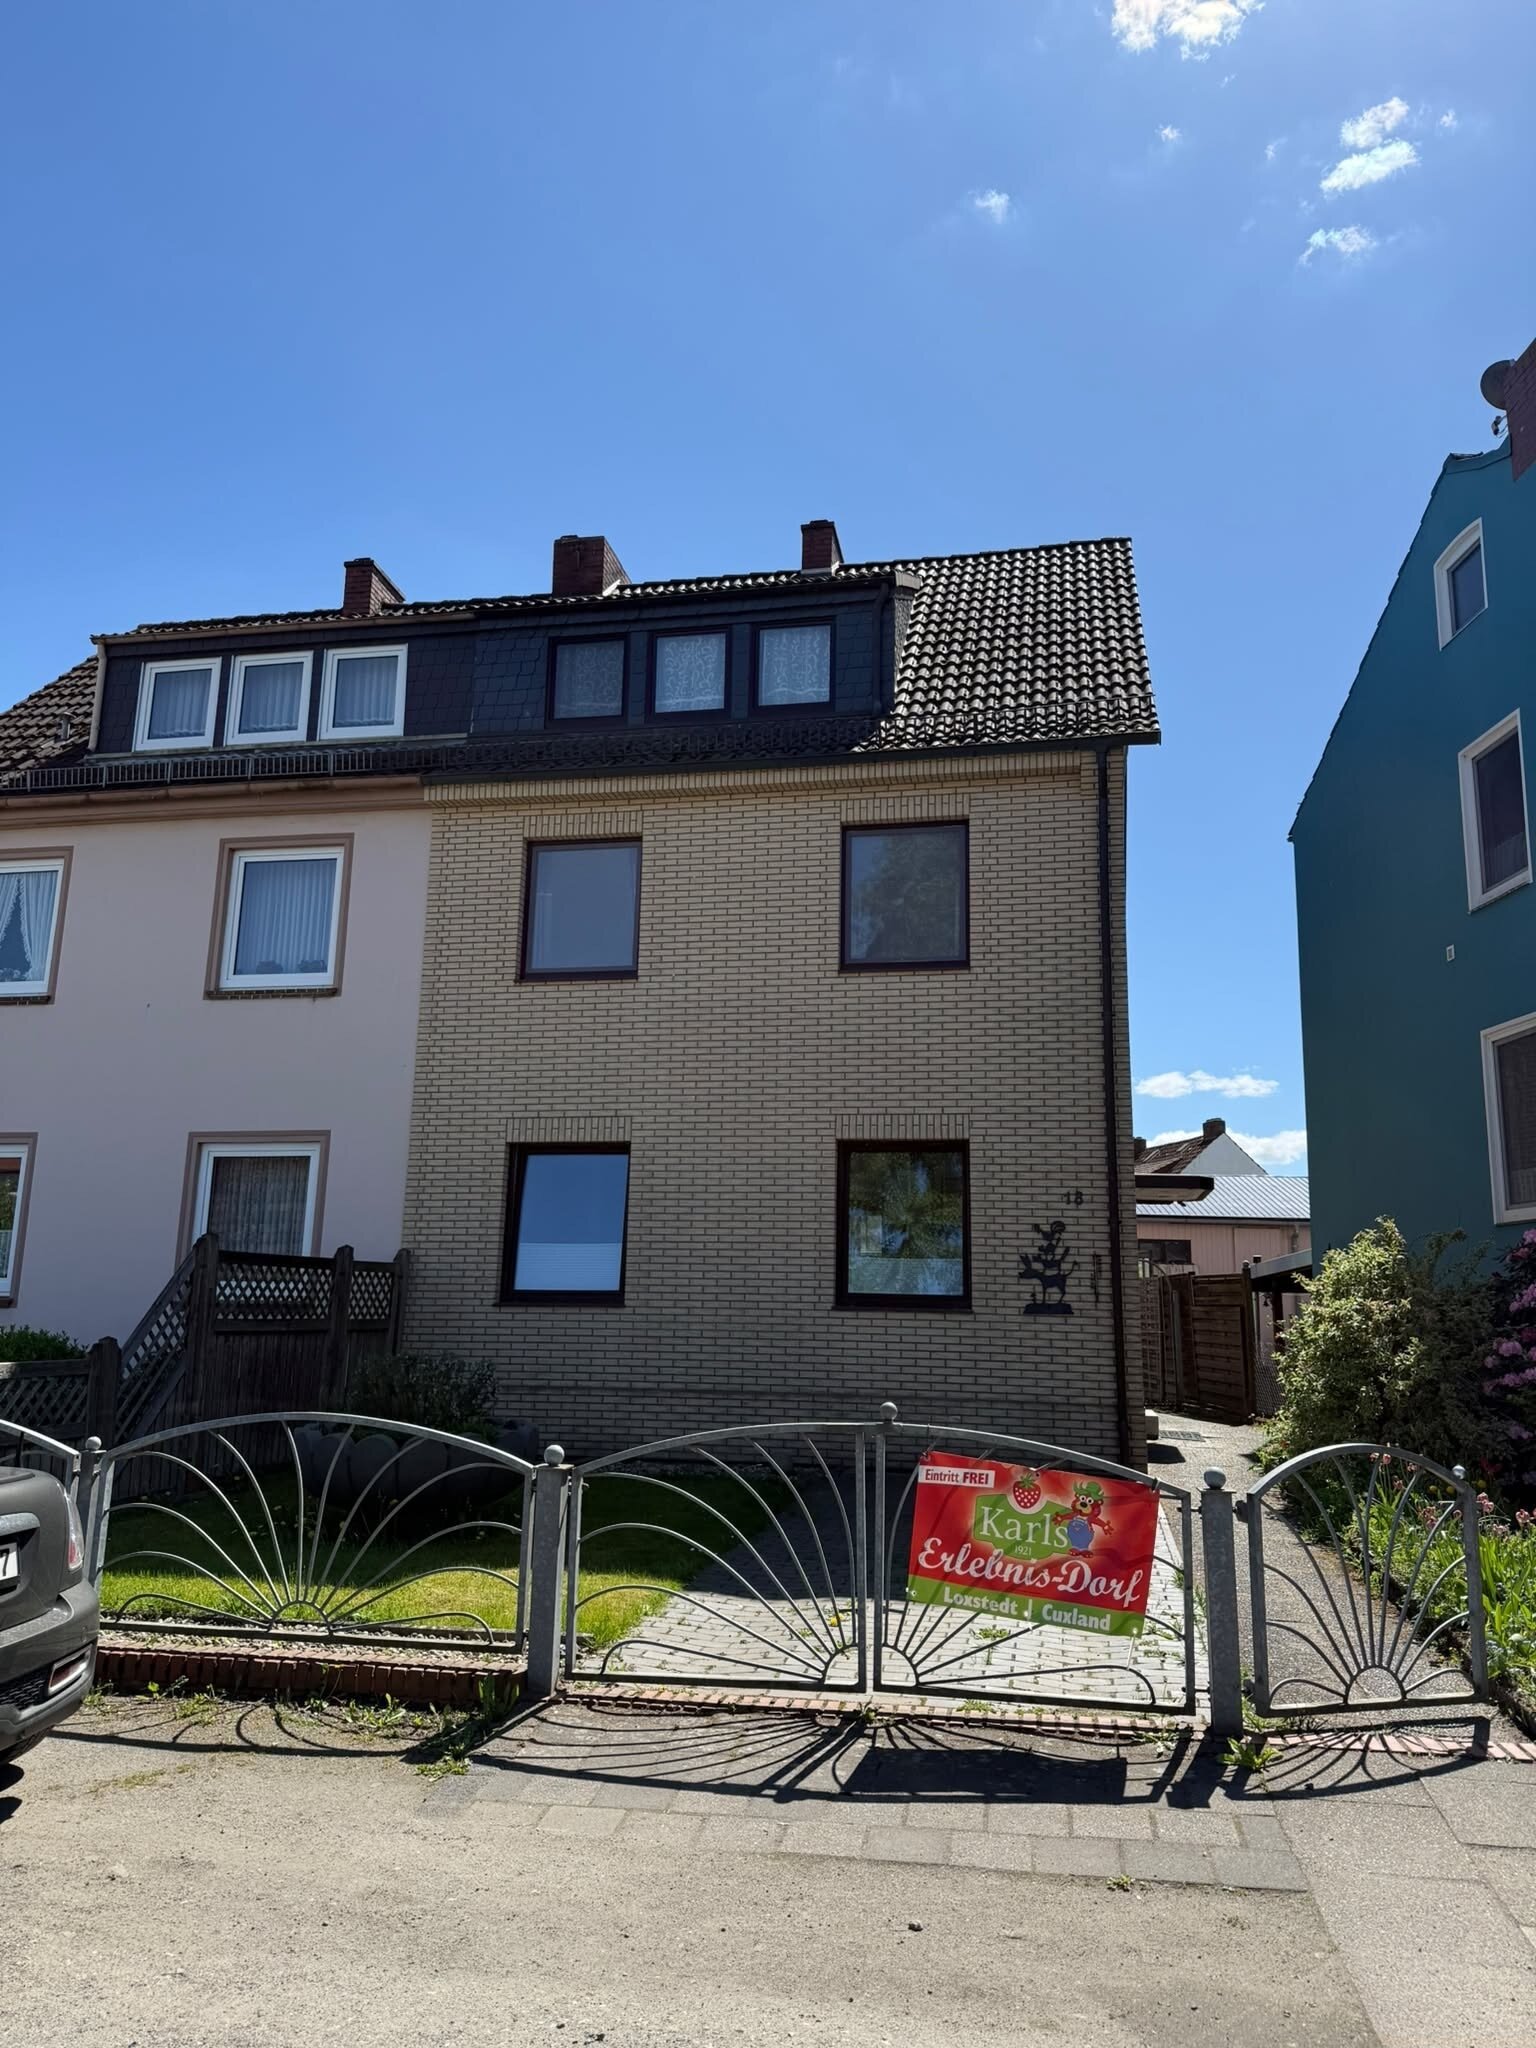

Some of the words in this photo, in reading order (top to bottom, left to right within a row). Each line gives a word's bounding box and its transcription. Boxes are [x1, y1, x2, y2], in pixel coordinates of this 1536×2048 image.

[1063, 1191, 1084, 1206] 18
[925, 1468, 960, 1483] Eintritt
[962, 1471, 989, 1485] FREI
[979, 1506, 1069, 1549] Karls
[1014, 1545, 1032, 1556] 1921
[917, 1537, 1144, 1608] Erlebnis-Dorf
[943, 1587, 1018, 1616] Loxstedt
[1041, 1603, 1112, 1632] Cuxland
